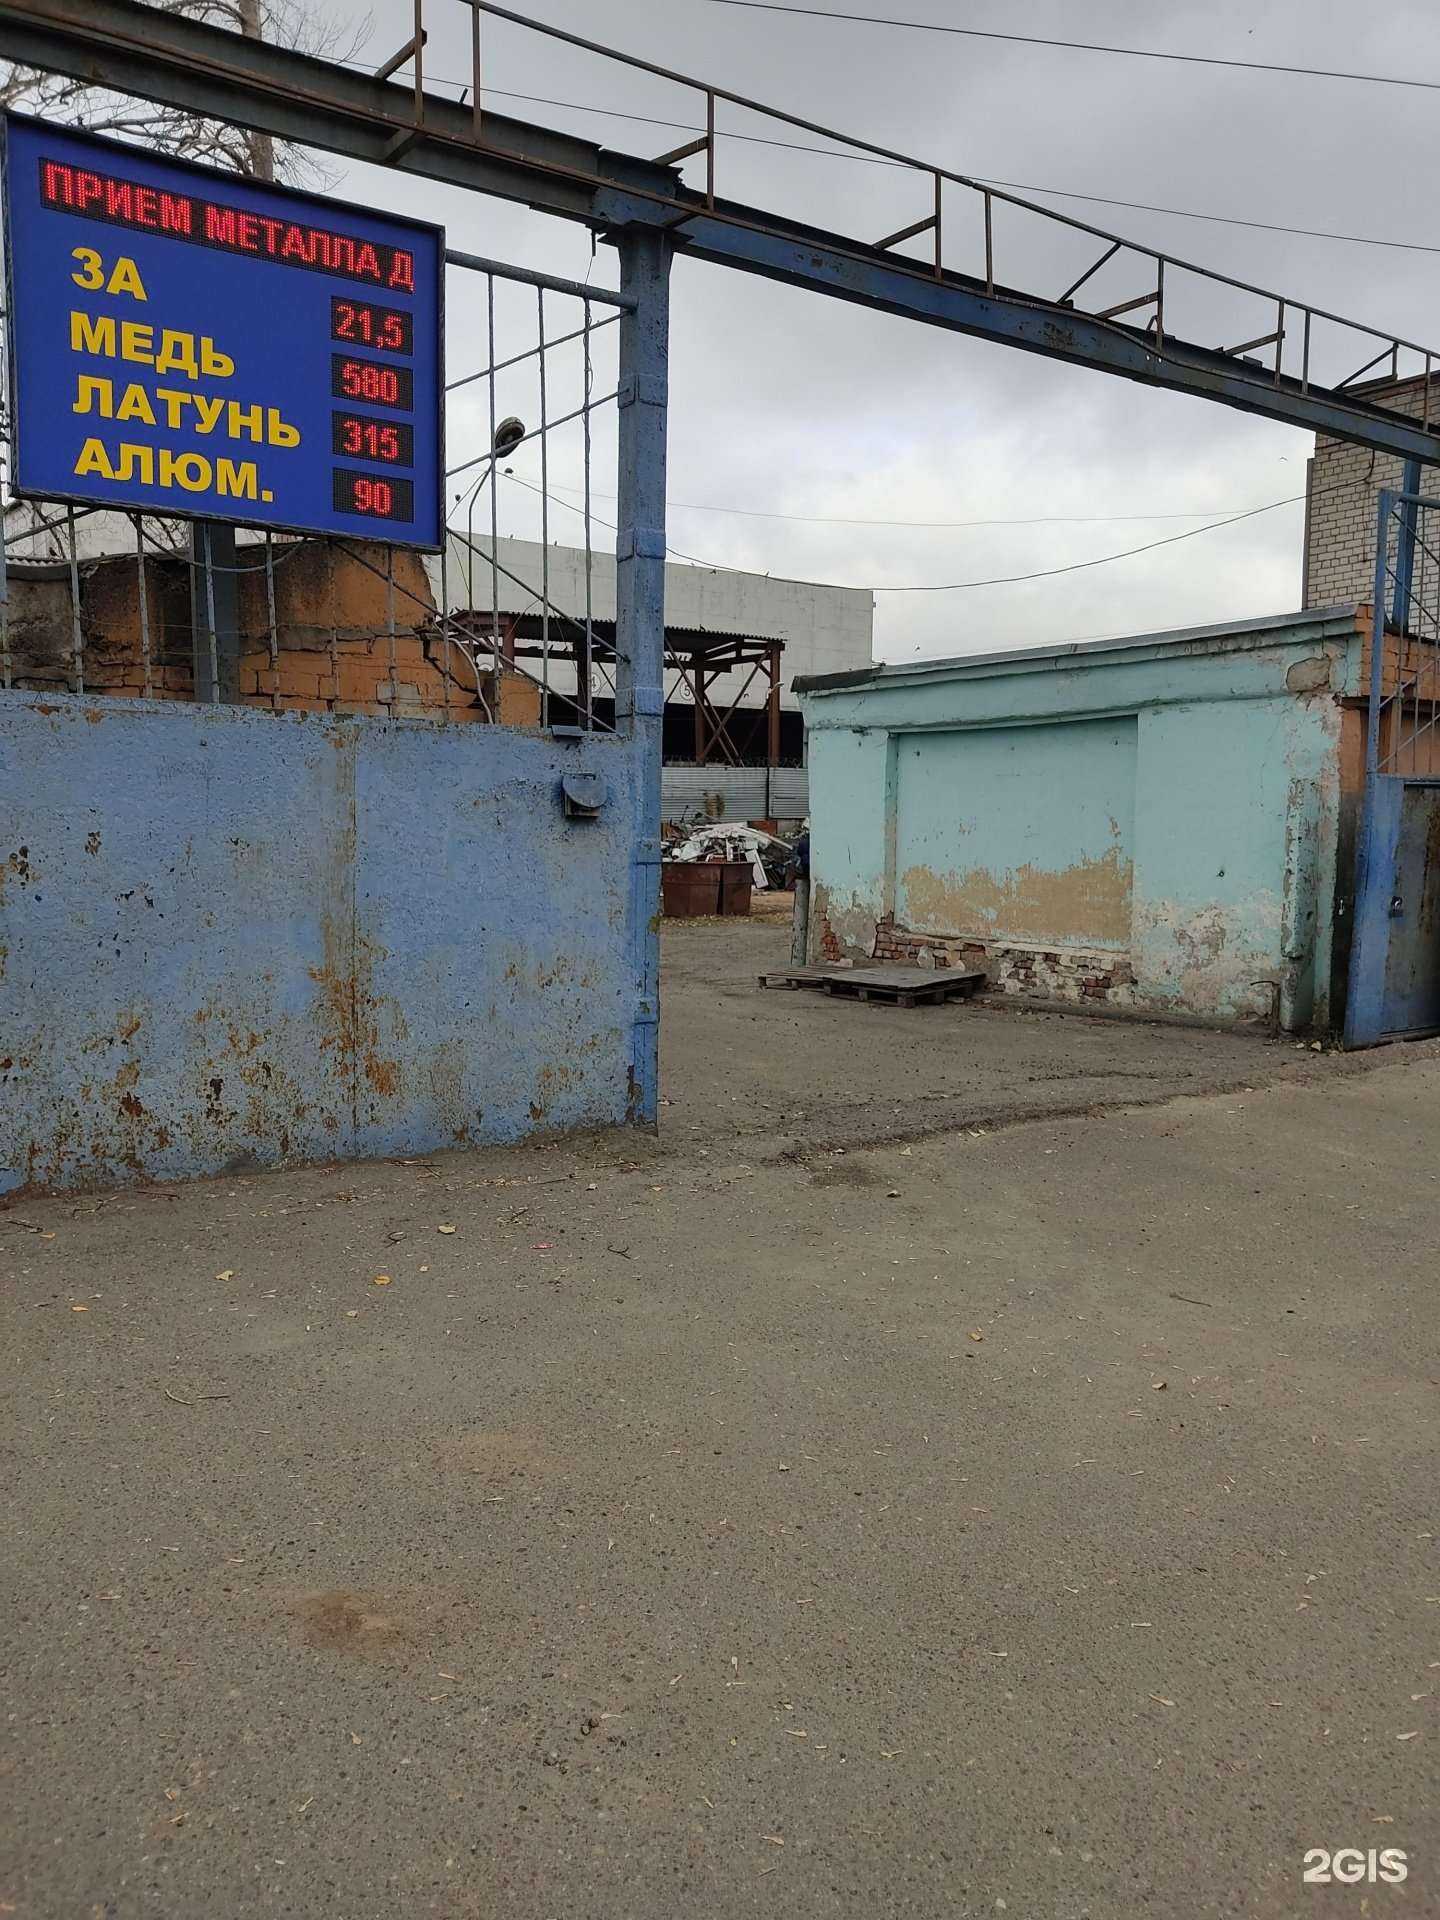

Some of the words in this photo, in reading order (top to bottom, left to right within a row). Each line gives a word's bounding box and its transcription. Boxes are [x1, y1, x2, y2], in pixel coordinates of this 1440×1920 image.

[46, 163, 192, 234] ПРИЕМ
[205, 205, 381, 279] МЕТАЛЛА
[71, 247, 148, 301] ЗА
[70, 310, 235, 380] МЕДЬ
[336, 304, 404, 350] 21,5
[342, 361, 398, 403] 580
[72, 374, 301, 448] ЛАТУНЬ
[343, 420, 399, 460] 315
[73, 437, 274, 503] АЛЮМ.
[352, 479, 393, 515] 90
